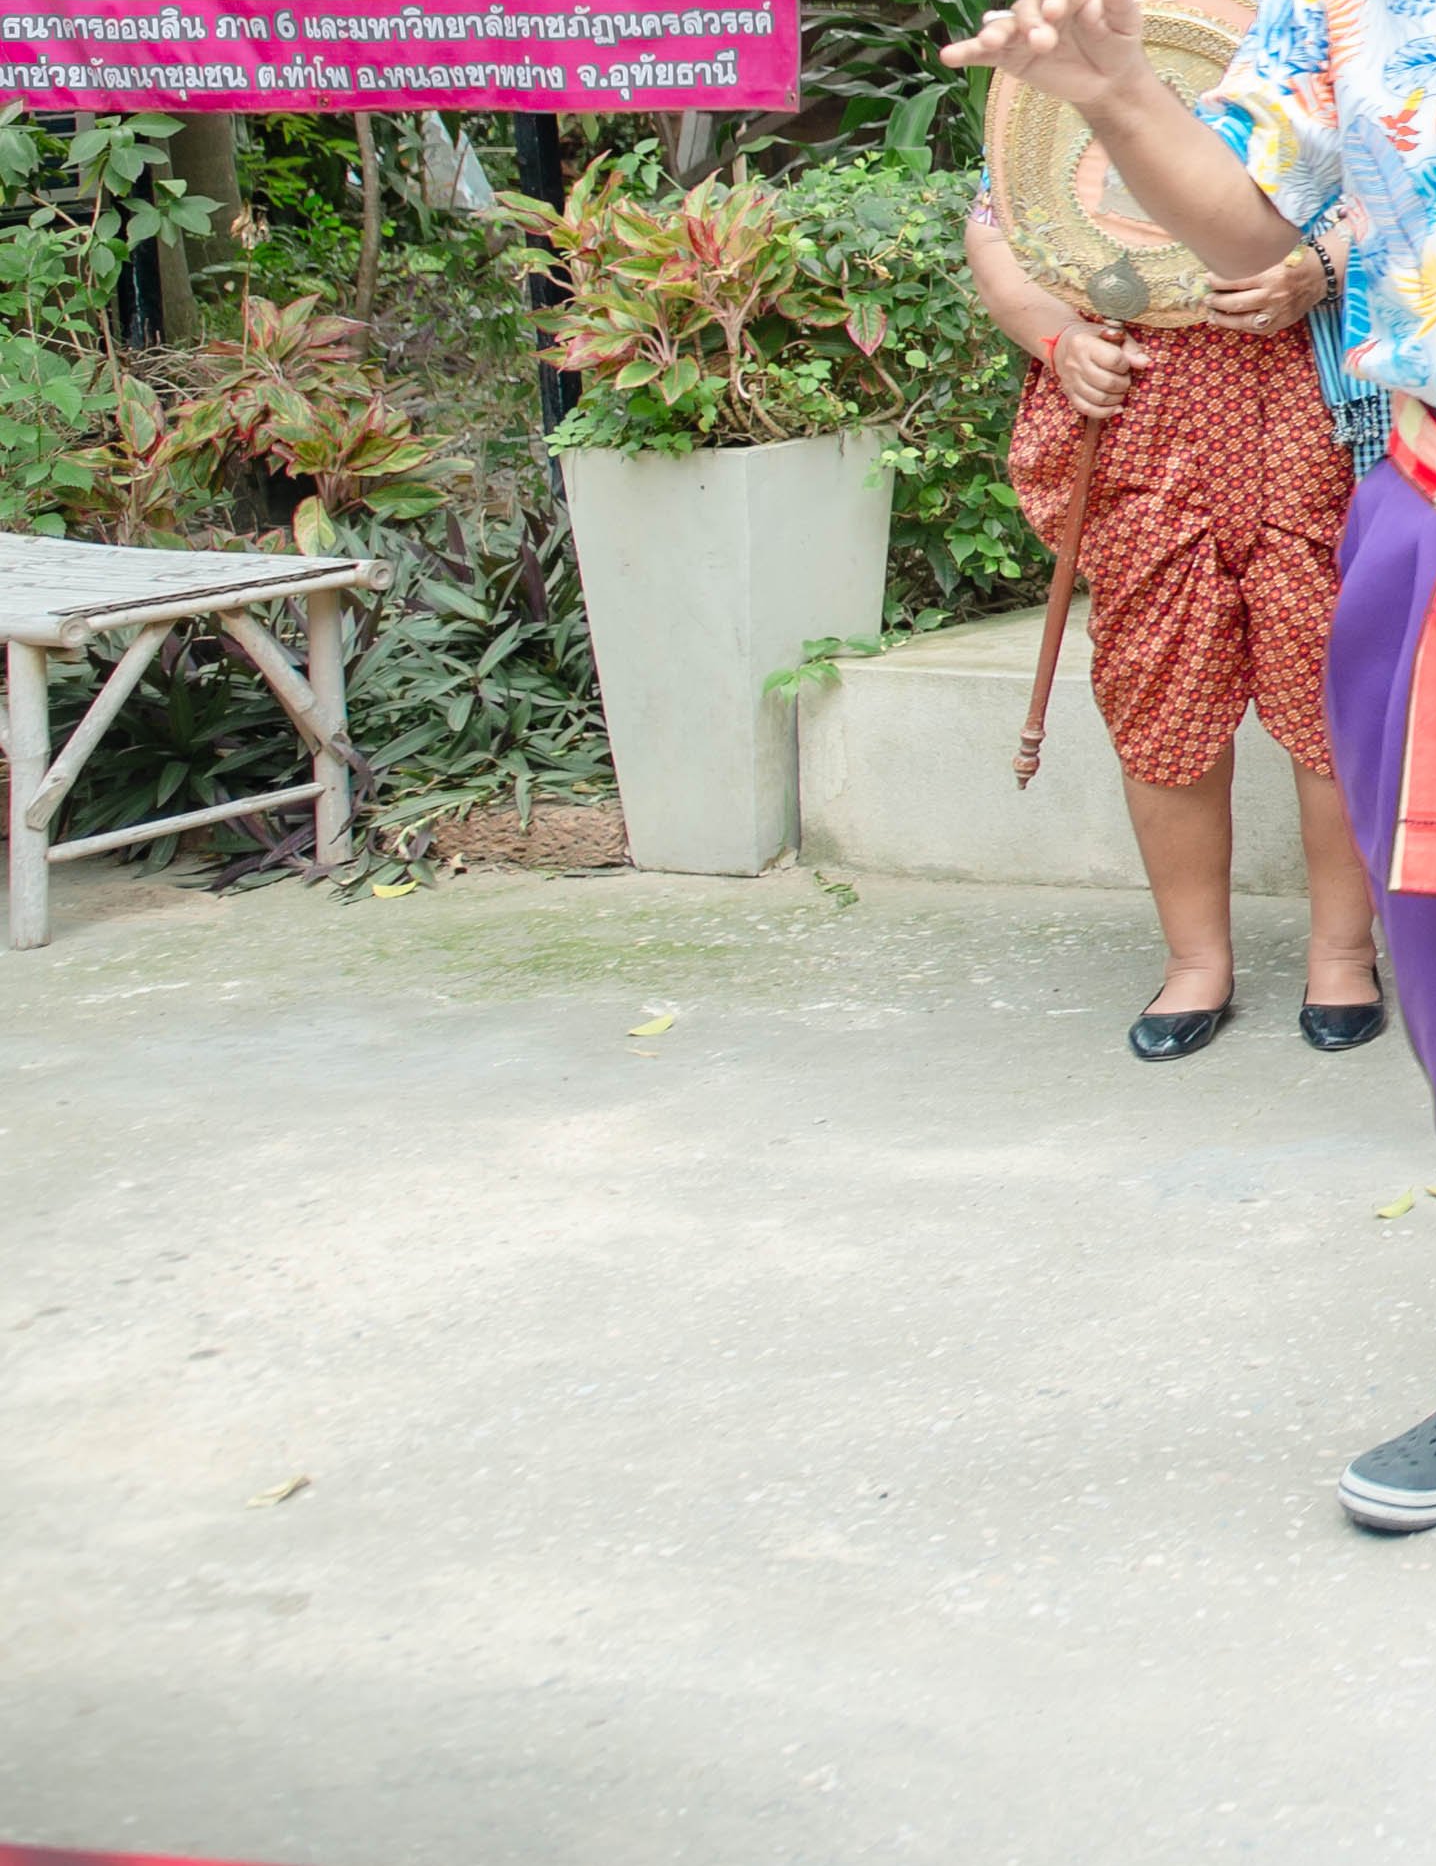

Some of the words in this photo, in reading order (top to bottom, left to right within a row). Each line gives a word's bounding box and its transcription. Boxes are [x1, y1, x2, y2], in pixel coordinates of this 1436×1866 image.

[3, 8, 205, 40] ธนาคารออมสิน
[216, 15, 267, 39] ภาค
[277, 13, 295, 38] 6
[304, 2, 772, 45] และมหาวิทยาลัยราชภัฏนครสวรรค์
[258, 57, 349, 88] ต.ท่าโพ
[358, 56, 564, 89] อ.หนองขาหย่าง
[577, 52, 737, 100] จ.อุทัยธานี
